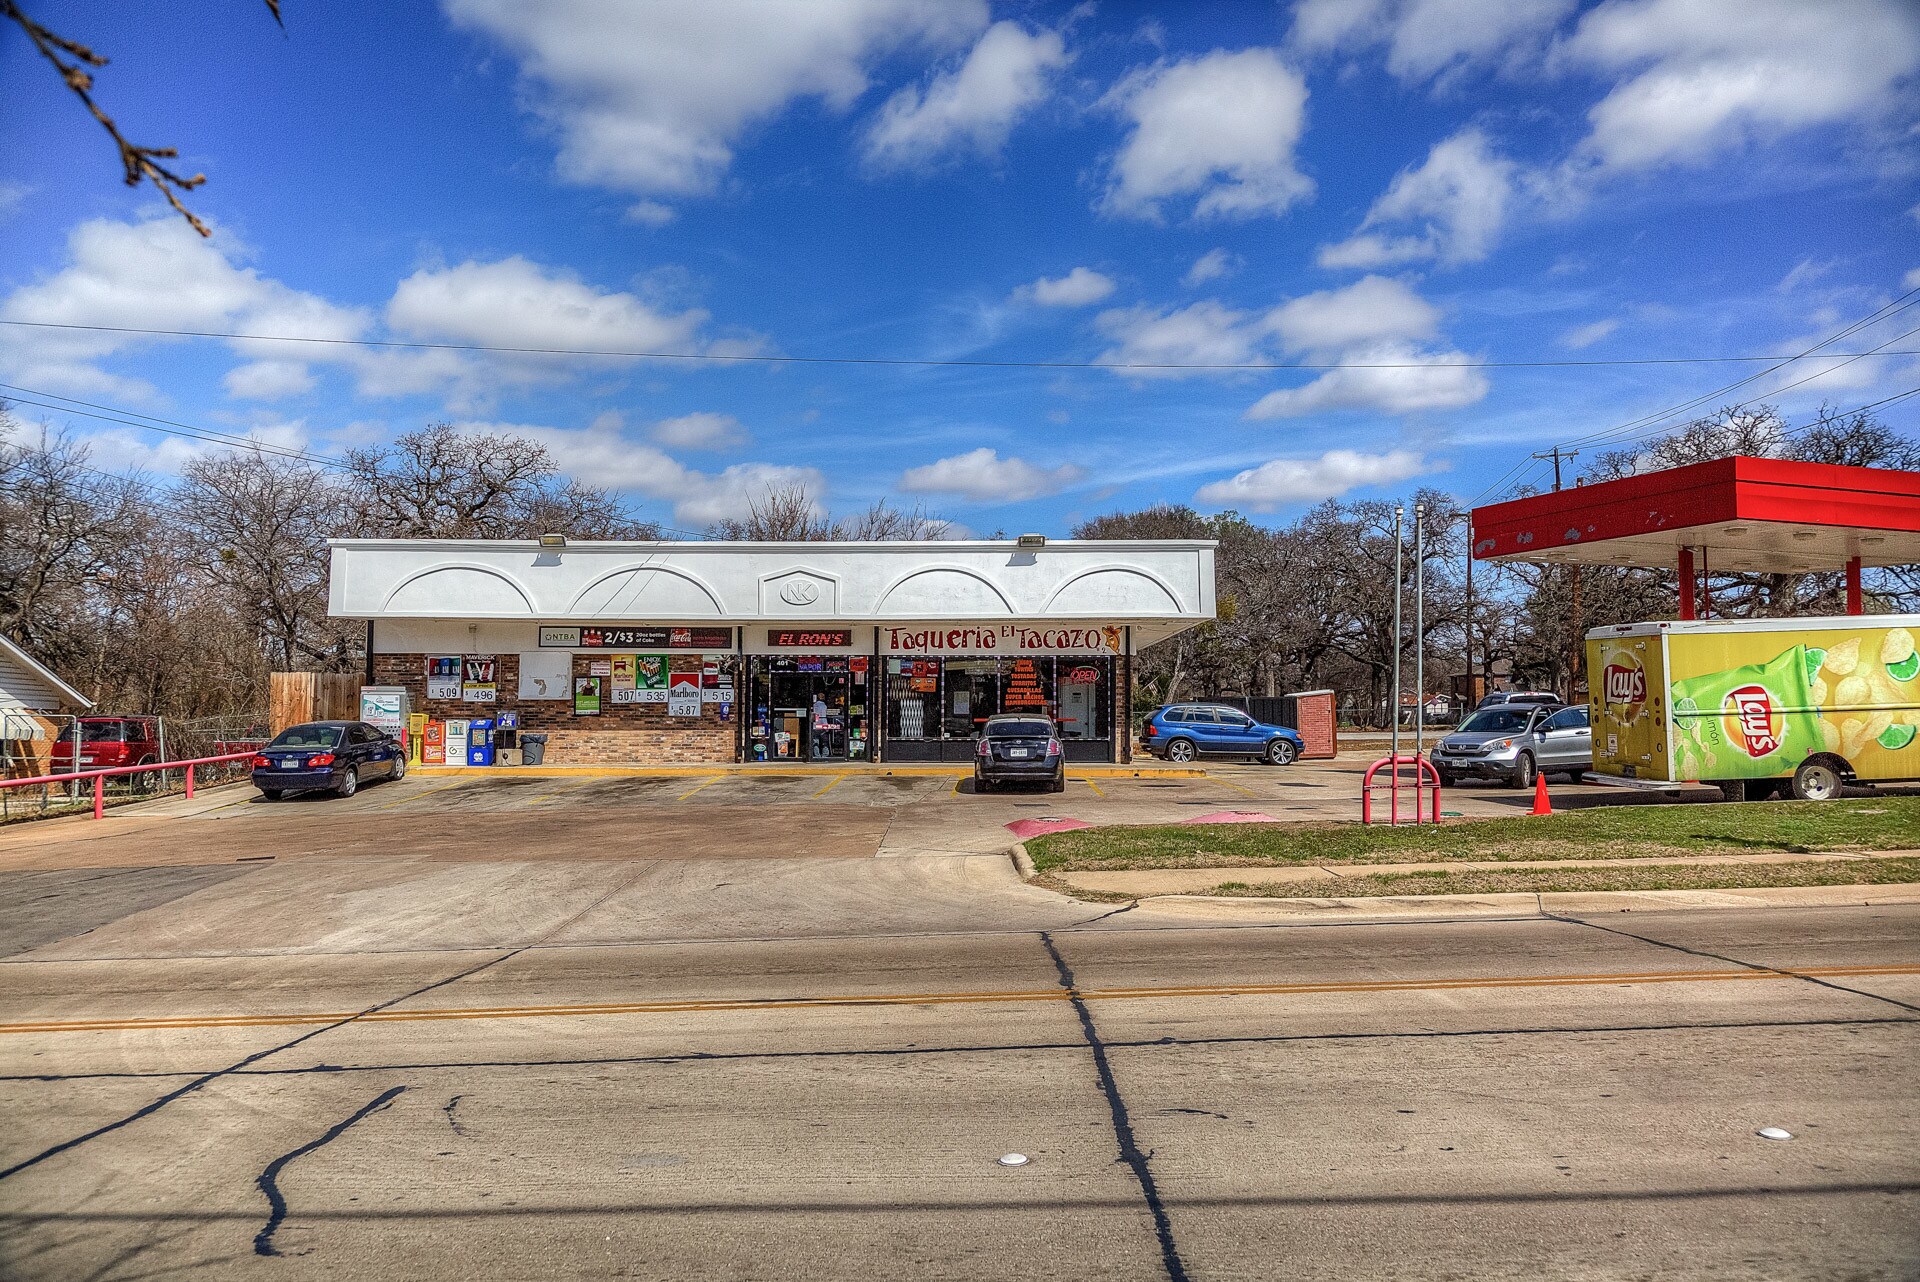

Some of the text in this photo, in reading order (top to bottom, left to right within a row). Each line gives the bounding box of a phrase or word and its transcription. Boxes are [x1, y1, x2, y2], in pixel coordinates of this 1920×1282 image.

[786, 583, 812, 602] NK
[604, 631, 634, 645] 2/$3
[779, 633, 843, 645] EL RON'S
[884, 625, 1101, 653] Taqueria El Tacazo
[1071, 669, 1098, 681] OPEN
[670, 687, 699, 698] Marlboro
[1606, 666, 1643, 704] Lay's
[1734, 693, 1774, 750] Lay's
